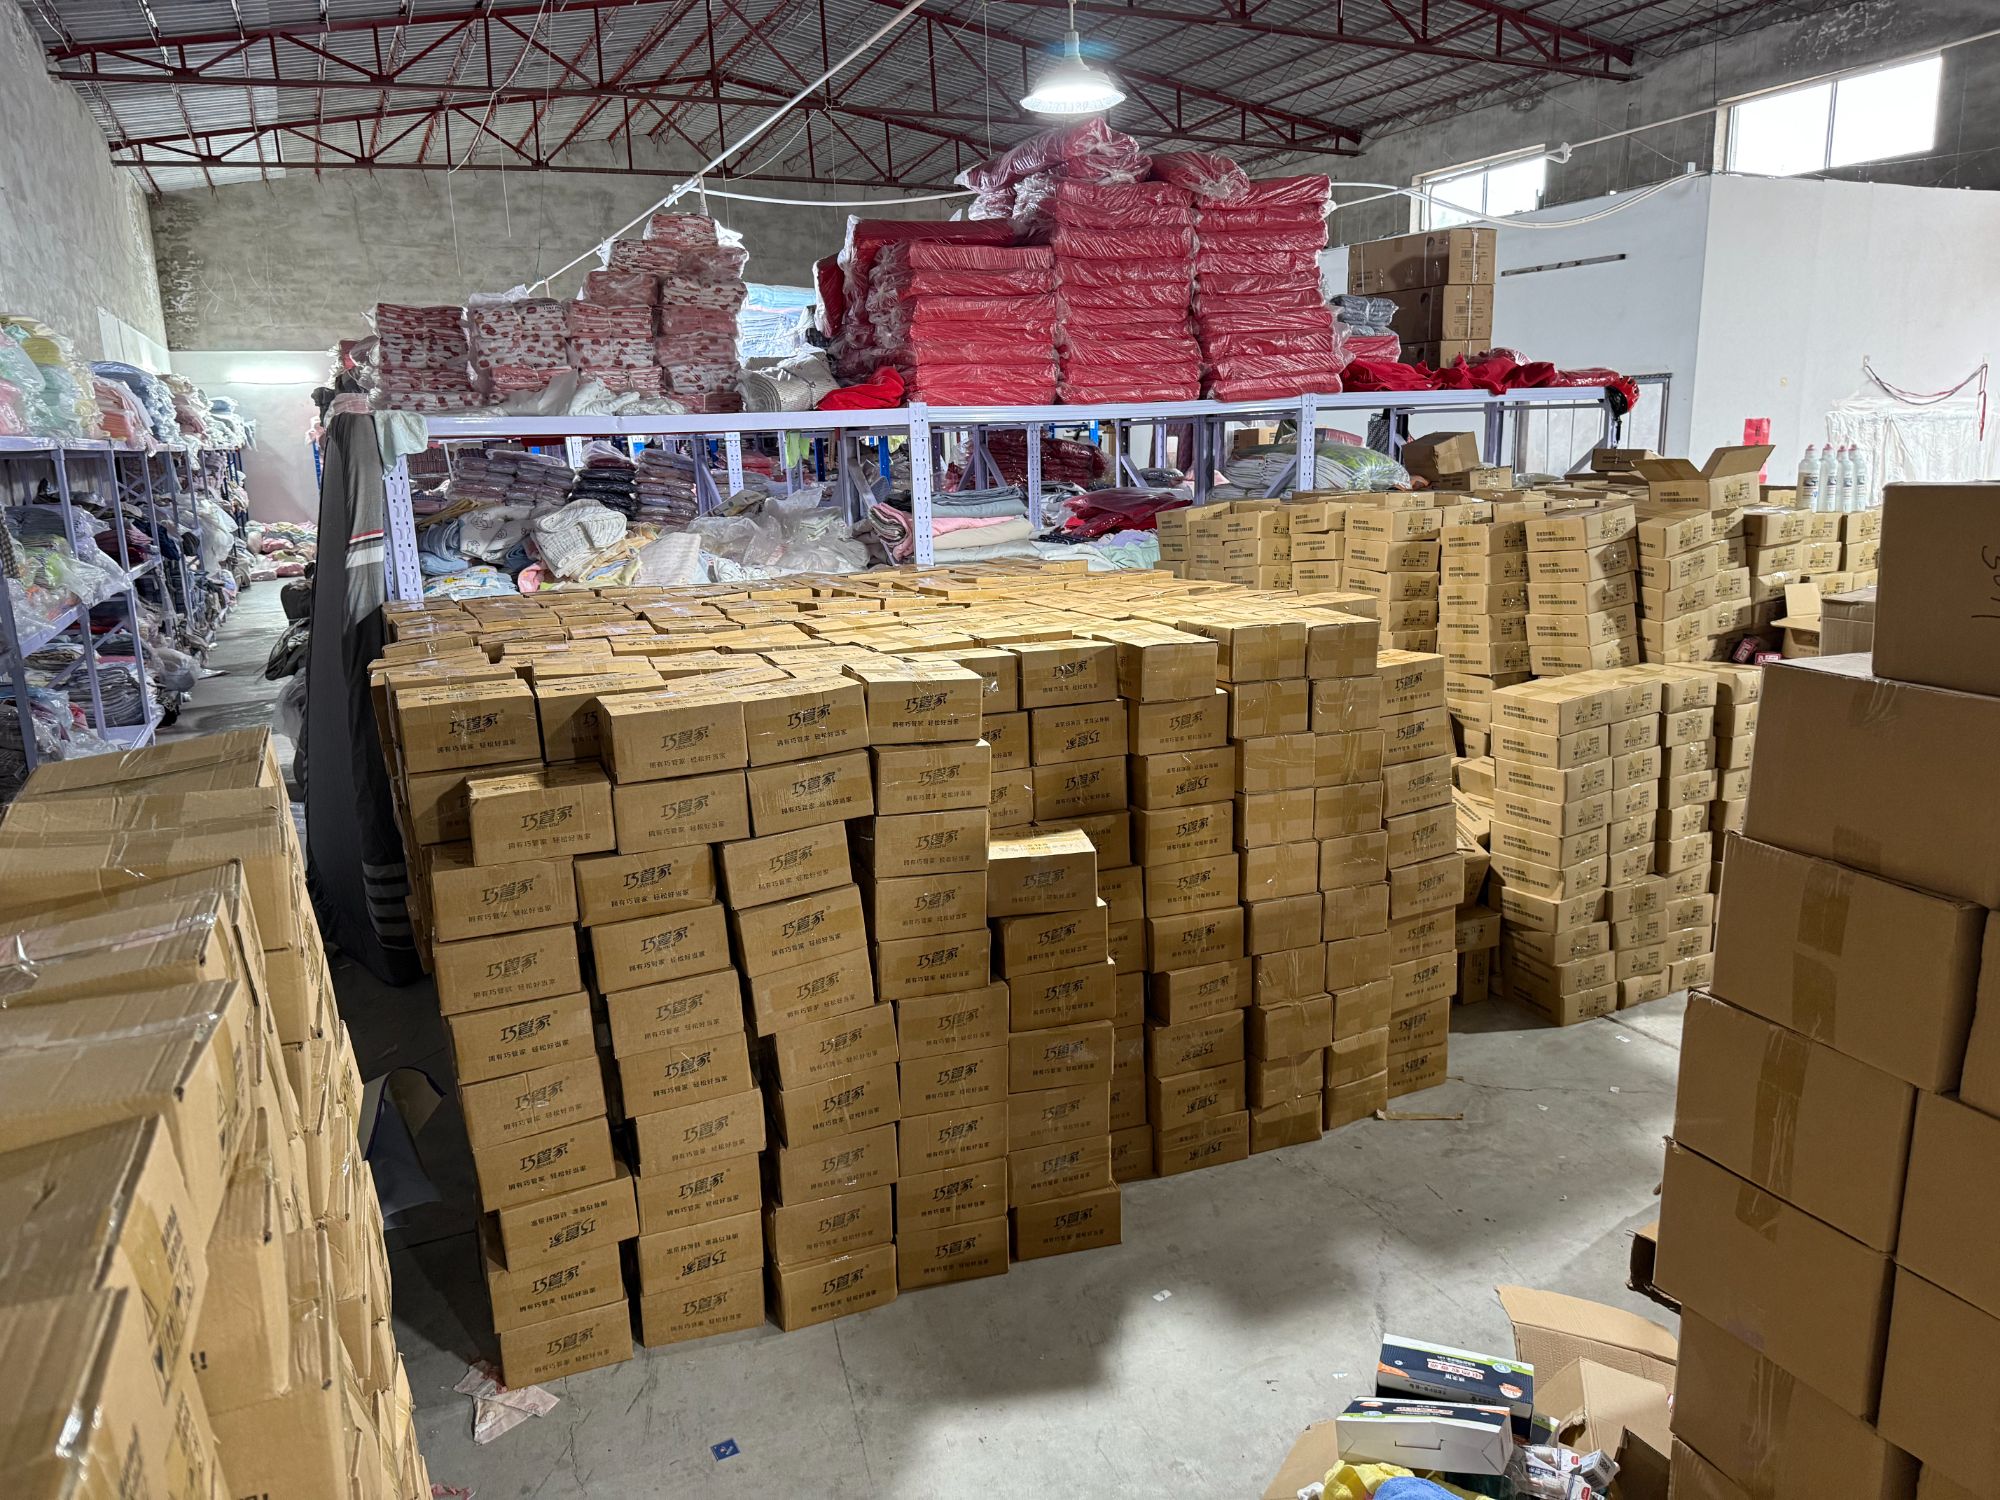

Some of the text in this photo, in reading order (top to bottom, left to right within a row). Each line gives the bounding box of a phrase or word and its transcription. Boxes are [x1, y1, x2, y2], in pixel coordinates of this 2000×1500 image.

[904, 693, 947, 713] 巧管家
[449, 713, 498, 735] 巧管家
[787, 704, 831, 729] 巧管家
[661, 726, 708, 751] 巧管家
[792, 772, 836, 797] 巧管家
[918, 765, 960, 786] 巧管家
[521, 806, 572, 831] 巧管家
[661, 795, 708, 820] 巧管家
[916, 830, 958, 850] 巧管家
[769, 845, 813, 872] 巧管家
[623, 863, 671, 889] 巧管家
[482, 878, 533, 905] 巧管家
[914, 889, 956, 911] 巧管家
[782, 910, 825, 939] 巧管家
[640, 926, 688, 954] 巧管家
[486, 952, 537, 979] 巧管家
[917, 947, 959, 969] 巧管家
[796, 972, 839, 1000] 巧管家
[656, 994, 703, 1021] 巧管家
[937, 1008, 978, 1030] 巧管家
[500, 1014, 550, 1043] 巧管家
[820, 1028, 862, 1055] 巧管家
[665, 1052, 710, 1079] 巧管家
[937, 1063, 978, 1085] 巧管家
[515, 1080, 563, 1111] 巧管家
[823, 1085, 864, 1113] 巧管家
[683, 1115, 728, 1143] 巧管家
[938, 1120, 978, 1143] 巧管家
[520, 1143, 568, 1172] 巧管家
[821, 1148, 864, 1173] 巧管家
[679, 1172, 724, 1199] 巧管家
[933, 1178, 973, 1201] 巧管家
[817, 1209, 860, 1234] 巧管家
[935, 1237, 976, 1259] 巧管家
[532, 1265, 579, 1295] 巧管家
[822, 1269, 863, 1296] 巧管家
[682, 1291, 728, 1316] 巧管家
[547, 1327, 594, 1355] 巧管家
